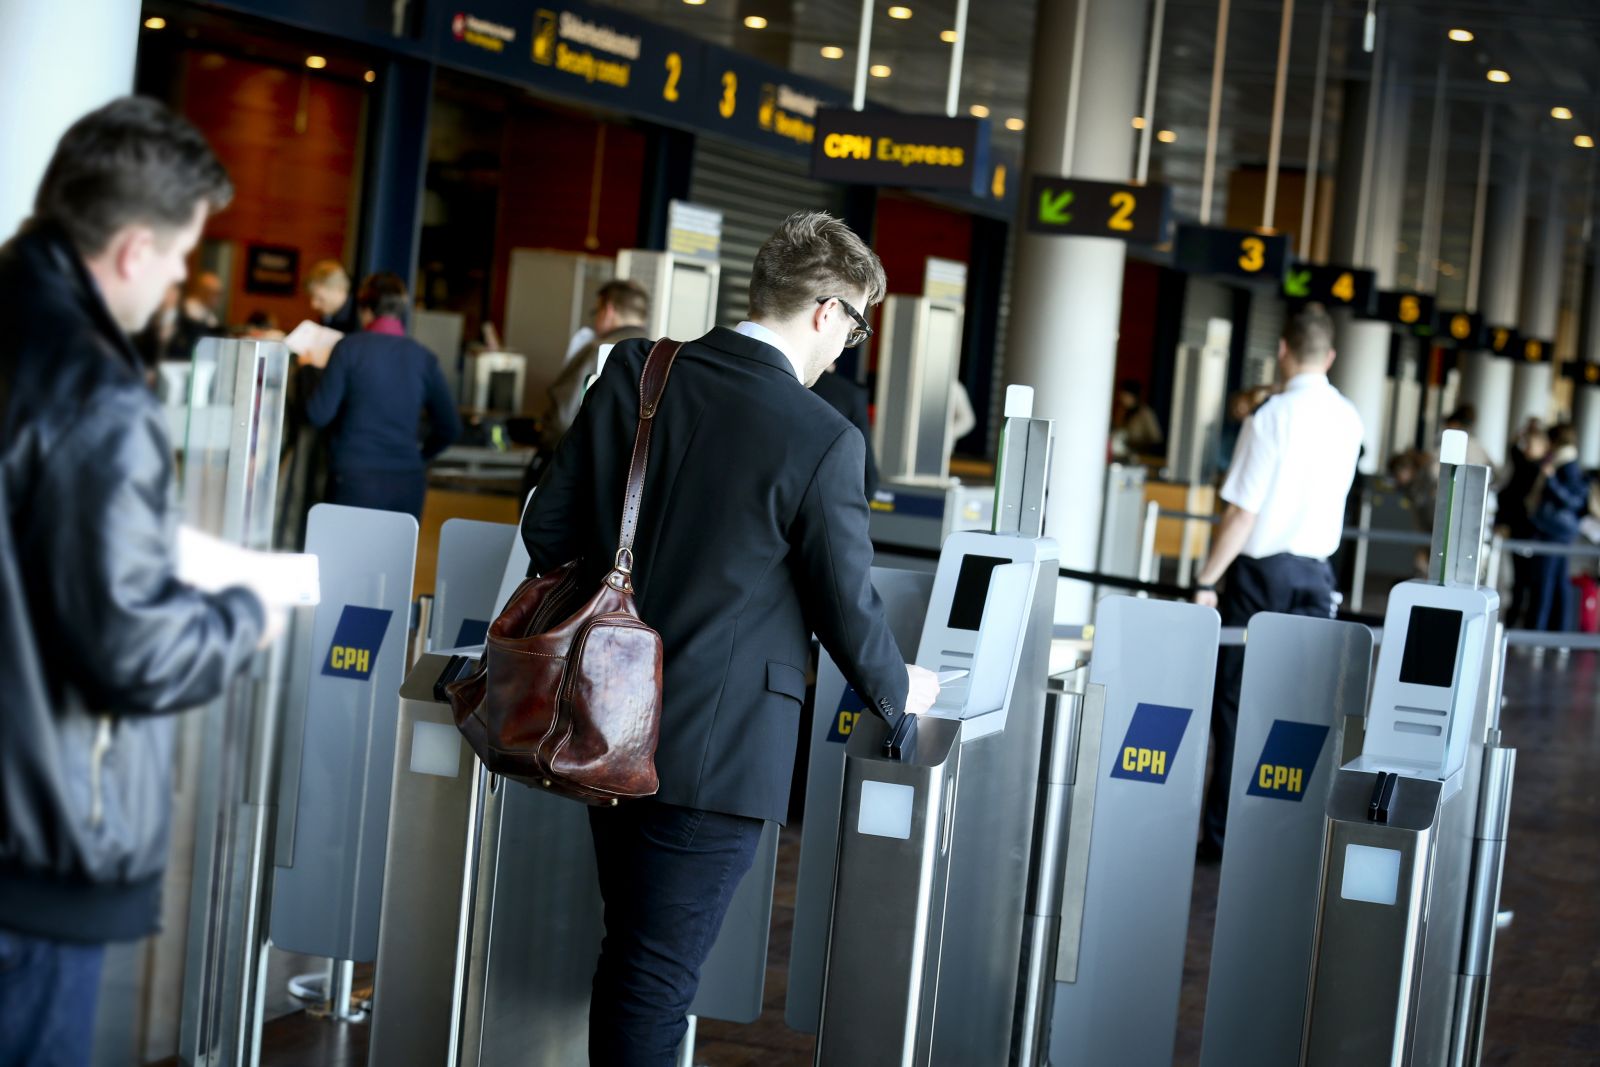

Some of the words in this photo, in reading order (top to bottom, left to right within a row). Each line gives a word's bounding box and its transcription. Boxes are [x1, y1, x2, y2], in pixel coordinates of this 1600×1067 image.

[663, 52, 682, 101] 2
[719, 71, 737, 118] 3
[824, 133, 872, 160] CPH
[876, 137, 964, 167] Express
[1107, 191, 1136, 231] 2
[1238, 238, 1265, 272] 3
[1331, 273, 1354, 301] 4
[331, 646, 369, 672] CPH
[1122, 746, 1166, 775] CPH
[1258, 763, 1303, 792] CPH
